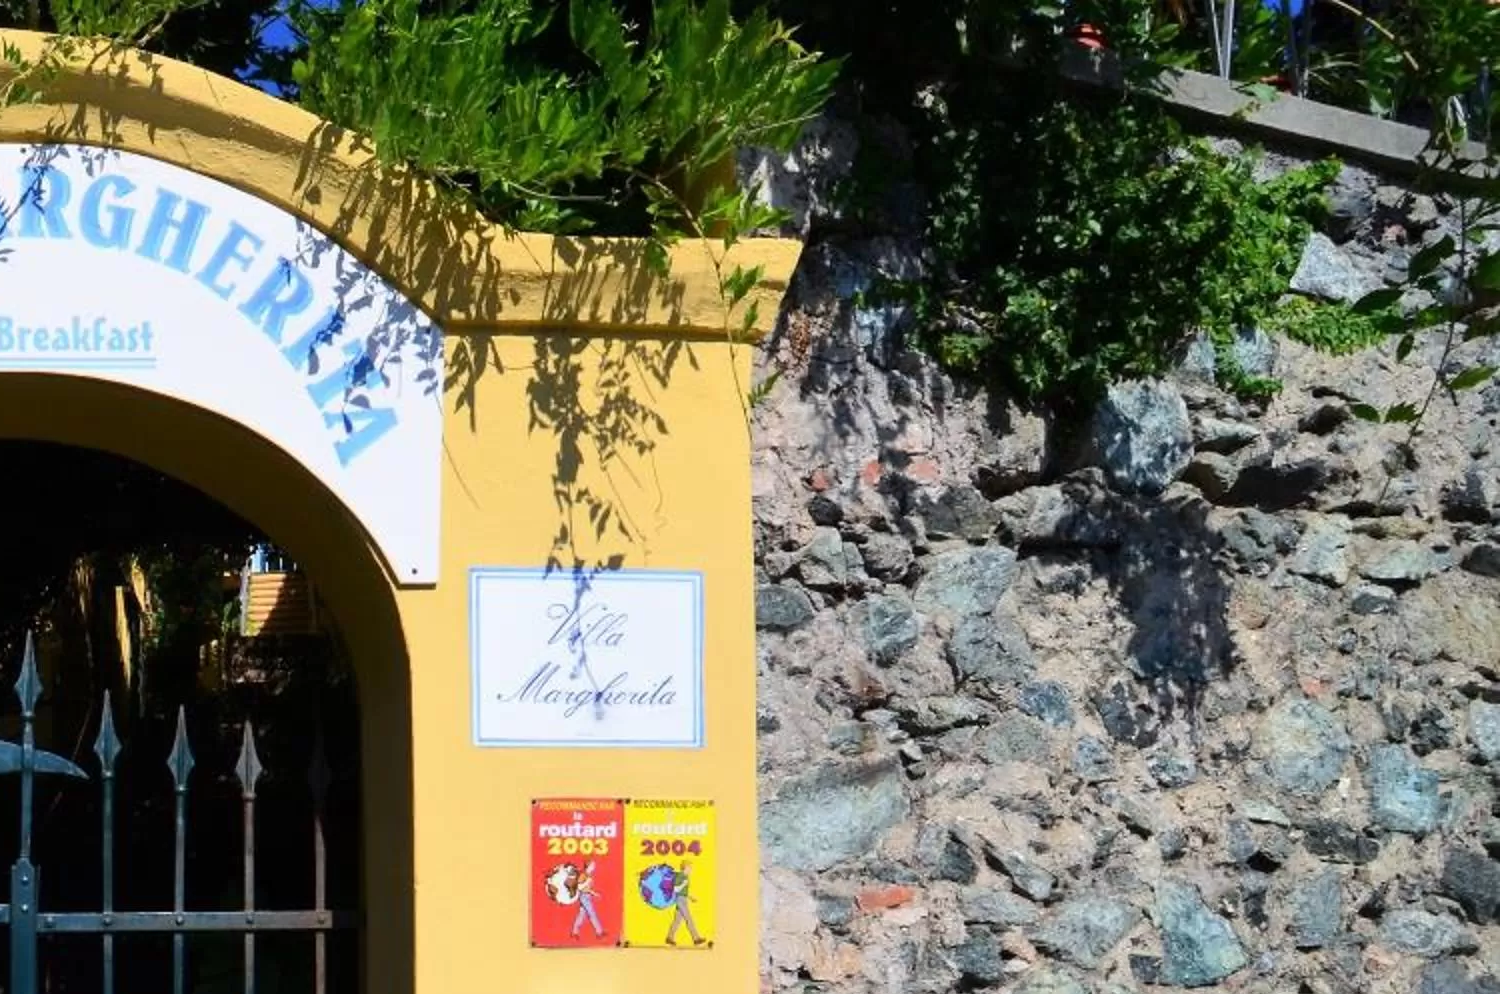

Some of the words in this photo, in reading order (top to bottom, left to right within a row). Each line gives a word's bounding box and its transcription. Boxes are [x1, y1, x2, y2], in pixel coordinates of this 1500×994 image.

[539, 821, 617, 838] routard
[633, 822, 707, 836] routard
[548, 838, 609, 856] 2003
[640, 839, 702, 857] 2004
